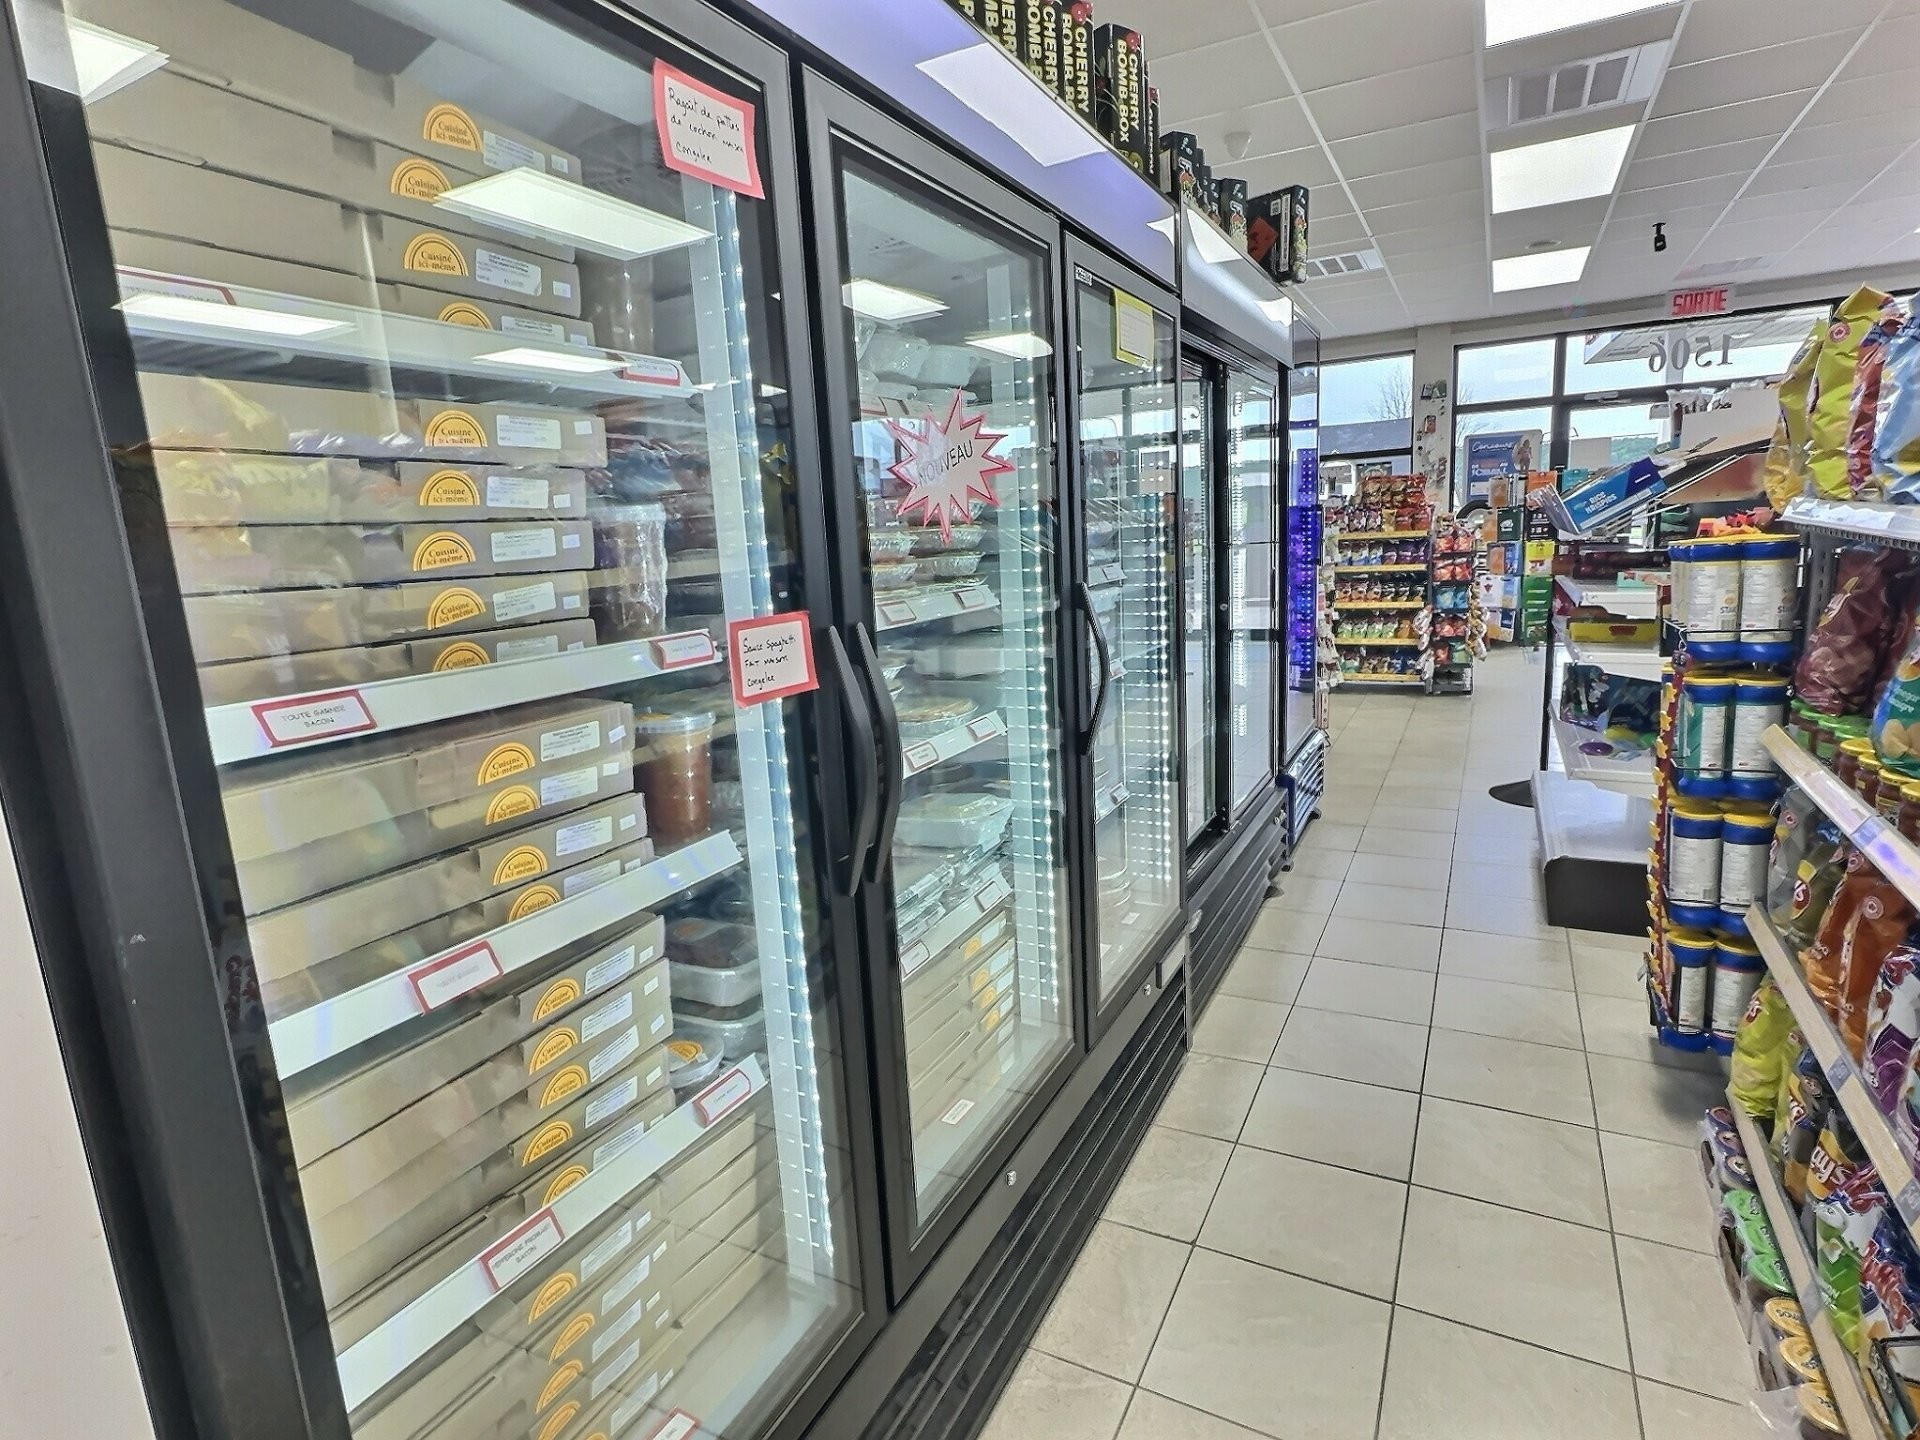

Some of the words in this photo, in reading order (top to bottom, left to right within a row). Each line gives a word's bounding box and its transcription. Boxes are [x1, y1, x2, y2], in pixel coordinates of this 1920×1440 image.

[1042, 5, 1059, 95] CHERRY
[1074, 26, 1090, 114] CHERRY
[1116, 39, 1129, 102] BOMB
[1127, 53, 1141, 131] CHERRY
[671, 114, 683, 126] de
[700, 106, 714, 121] de
[1117, 103, 1130, 144] BOX
[1671, 289, 1729, 317] SORTIE
[917, 439, 974, 488] NOUVEAU
[1589, 491, 1607, 504] RICE
[281, 711, 312, 722] TOUTE
[304, 717, 336, 728] BACON
